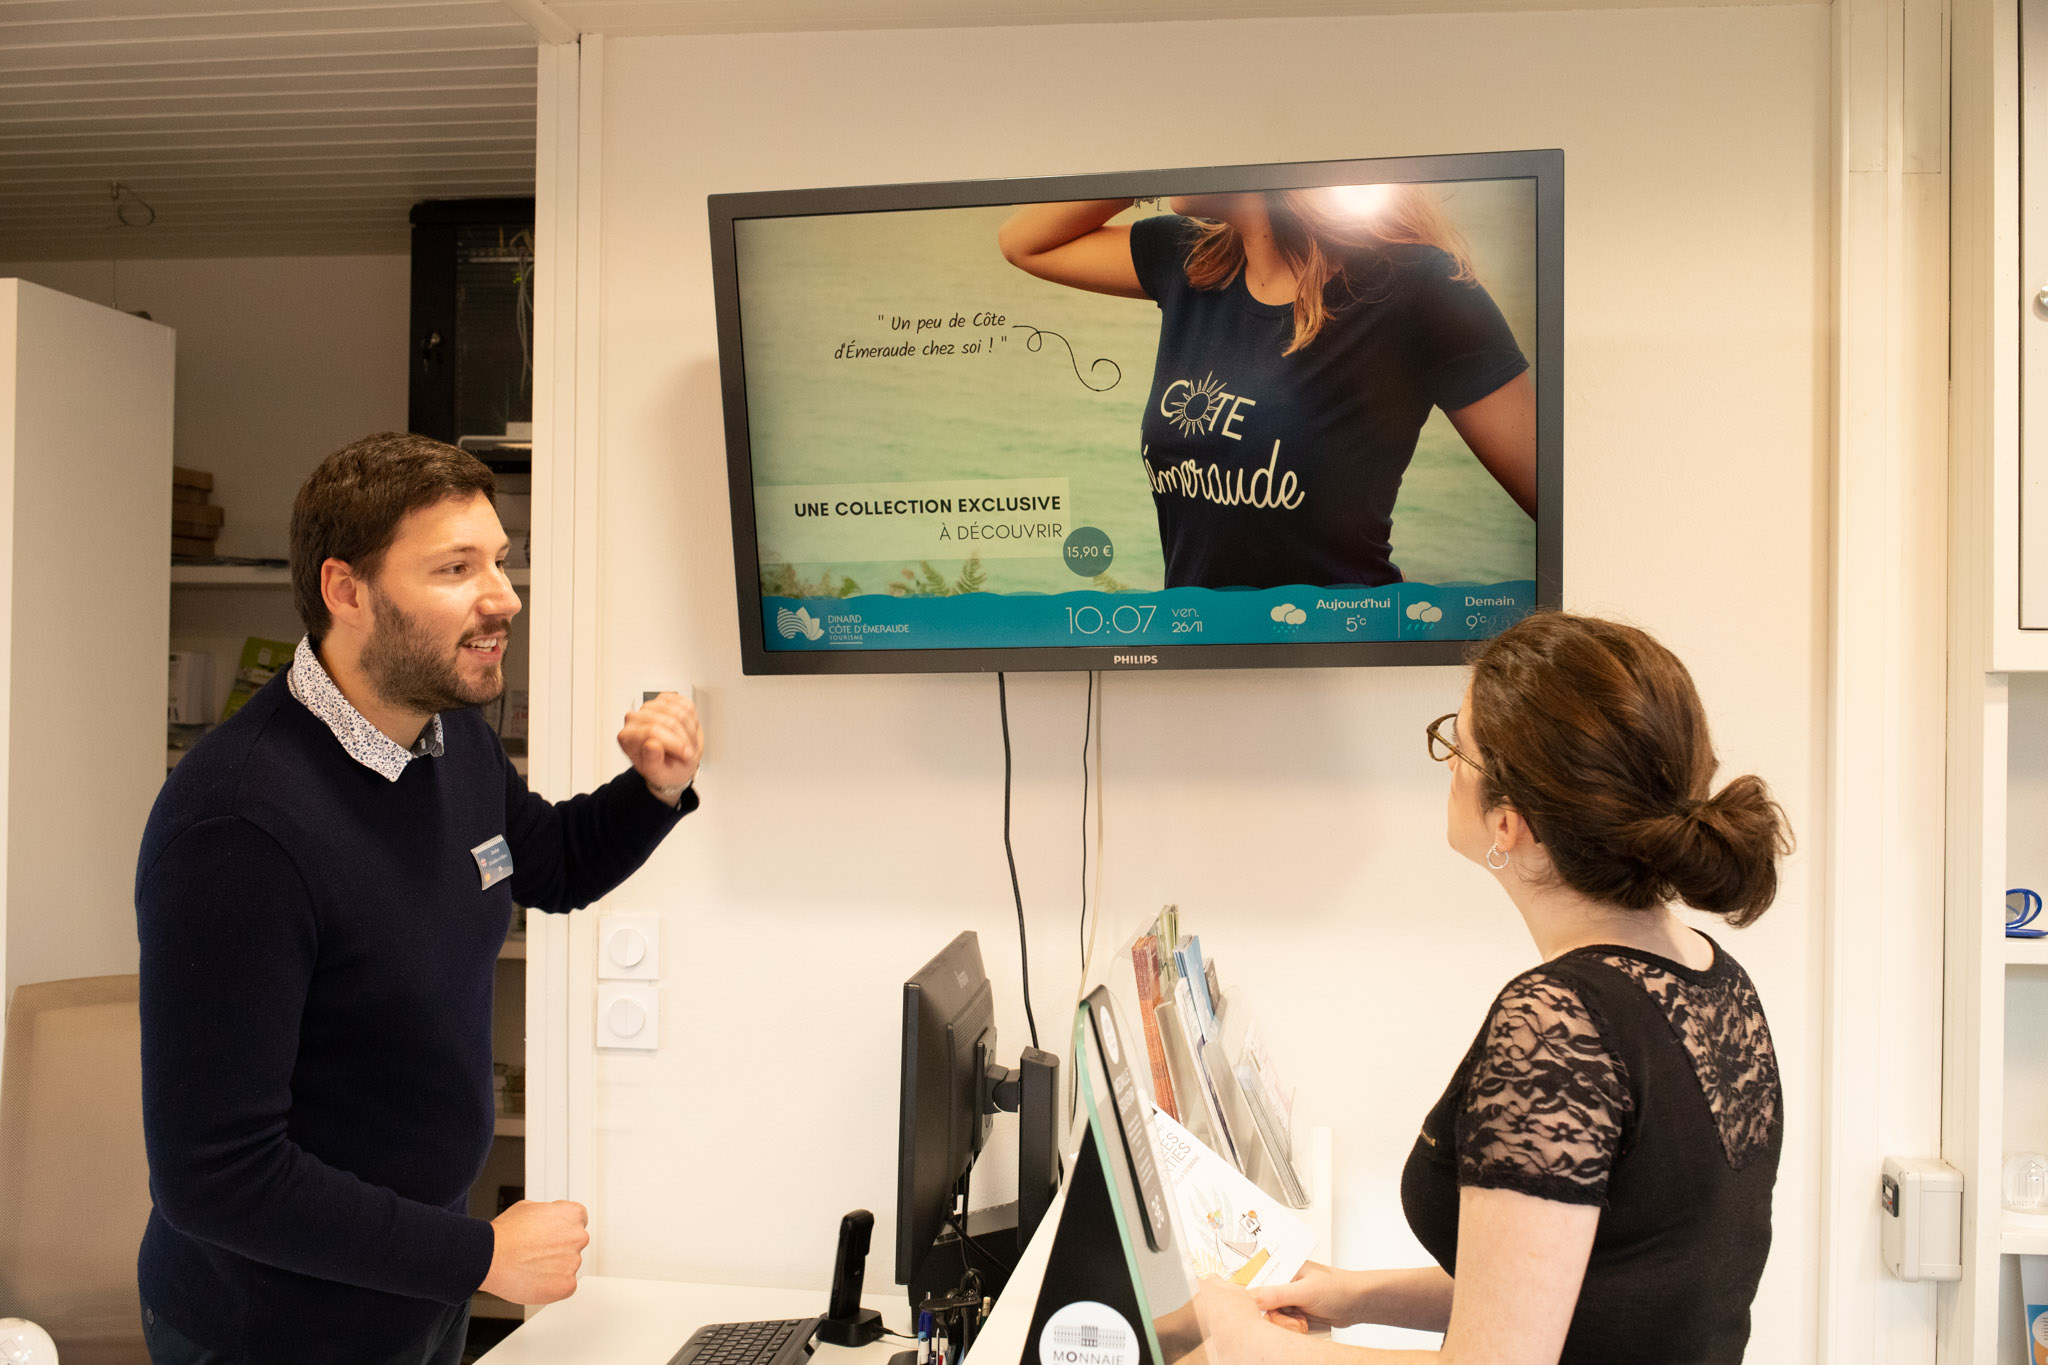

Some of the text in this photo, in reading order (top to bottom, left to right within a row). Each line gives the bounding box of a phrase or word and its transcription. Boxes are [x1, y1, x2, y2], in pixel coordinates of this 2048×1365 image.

[891, 315, 911, 331] Un
[916, 316, 942, 334] peu
[948, 312, 966, 328] de
[972, 311, 1006, 327] Côte
[834, 339, 916, 360] d'Émeraude
[922, 340, 956, 356] chez
[960, 340, 982, 355] soi
[794, 495, 1061, 517] UNE COLLECTION EXCLUSIVE
[939, 521, 1063, 541] À DÉCOUVRIR
[1066, 545, 1112, 560] 15,90 €
[1316, 598, 1391, 612] Aujourd'hui
[1465, 595, 1515, 607] Demain
[828, 614, 862, 624] DINARD
[1171, 607, 1200, 618] ven.
[1065, 605, 1157, 635] 10:07
[1171, 620, 1203, 633] 26/11
[828, 623, 910, 634] CÔTE D'ÉMERAUDE
[1113, 655, 1159, 665] PHILIPS
[1053, 1350, 1125, 1365] MONNAIE
